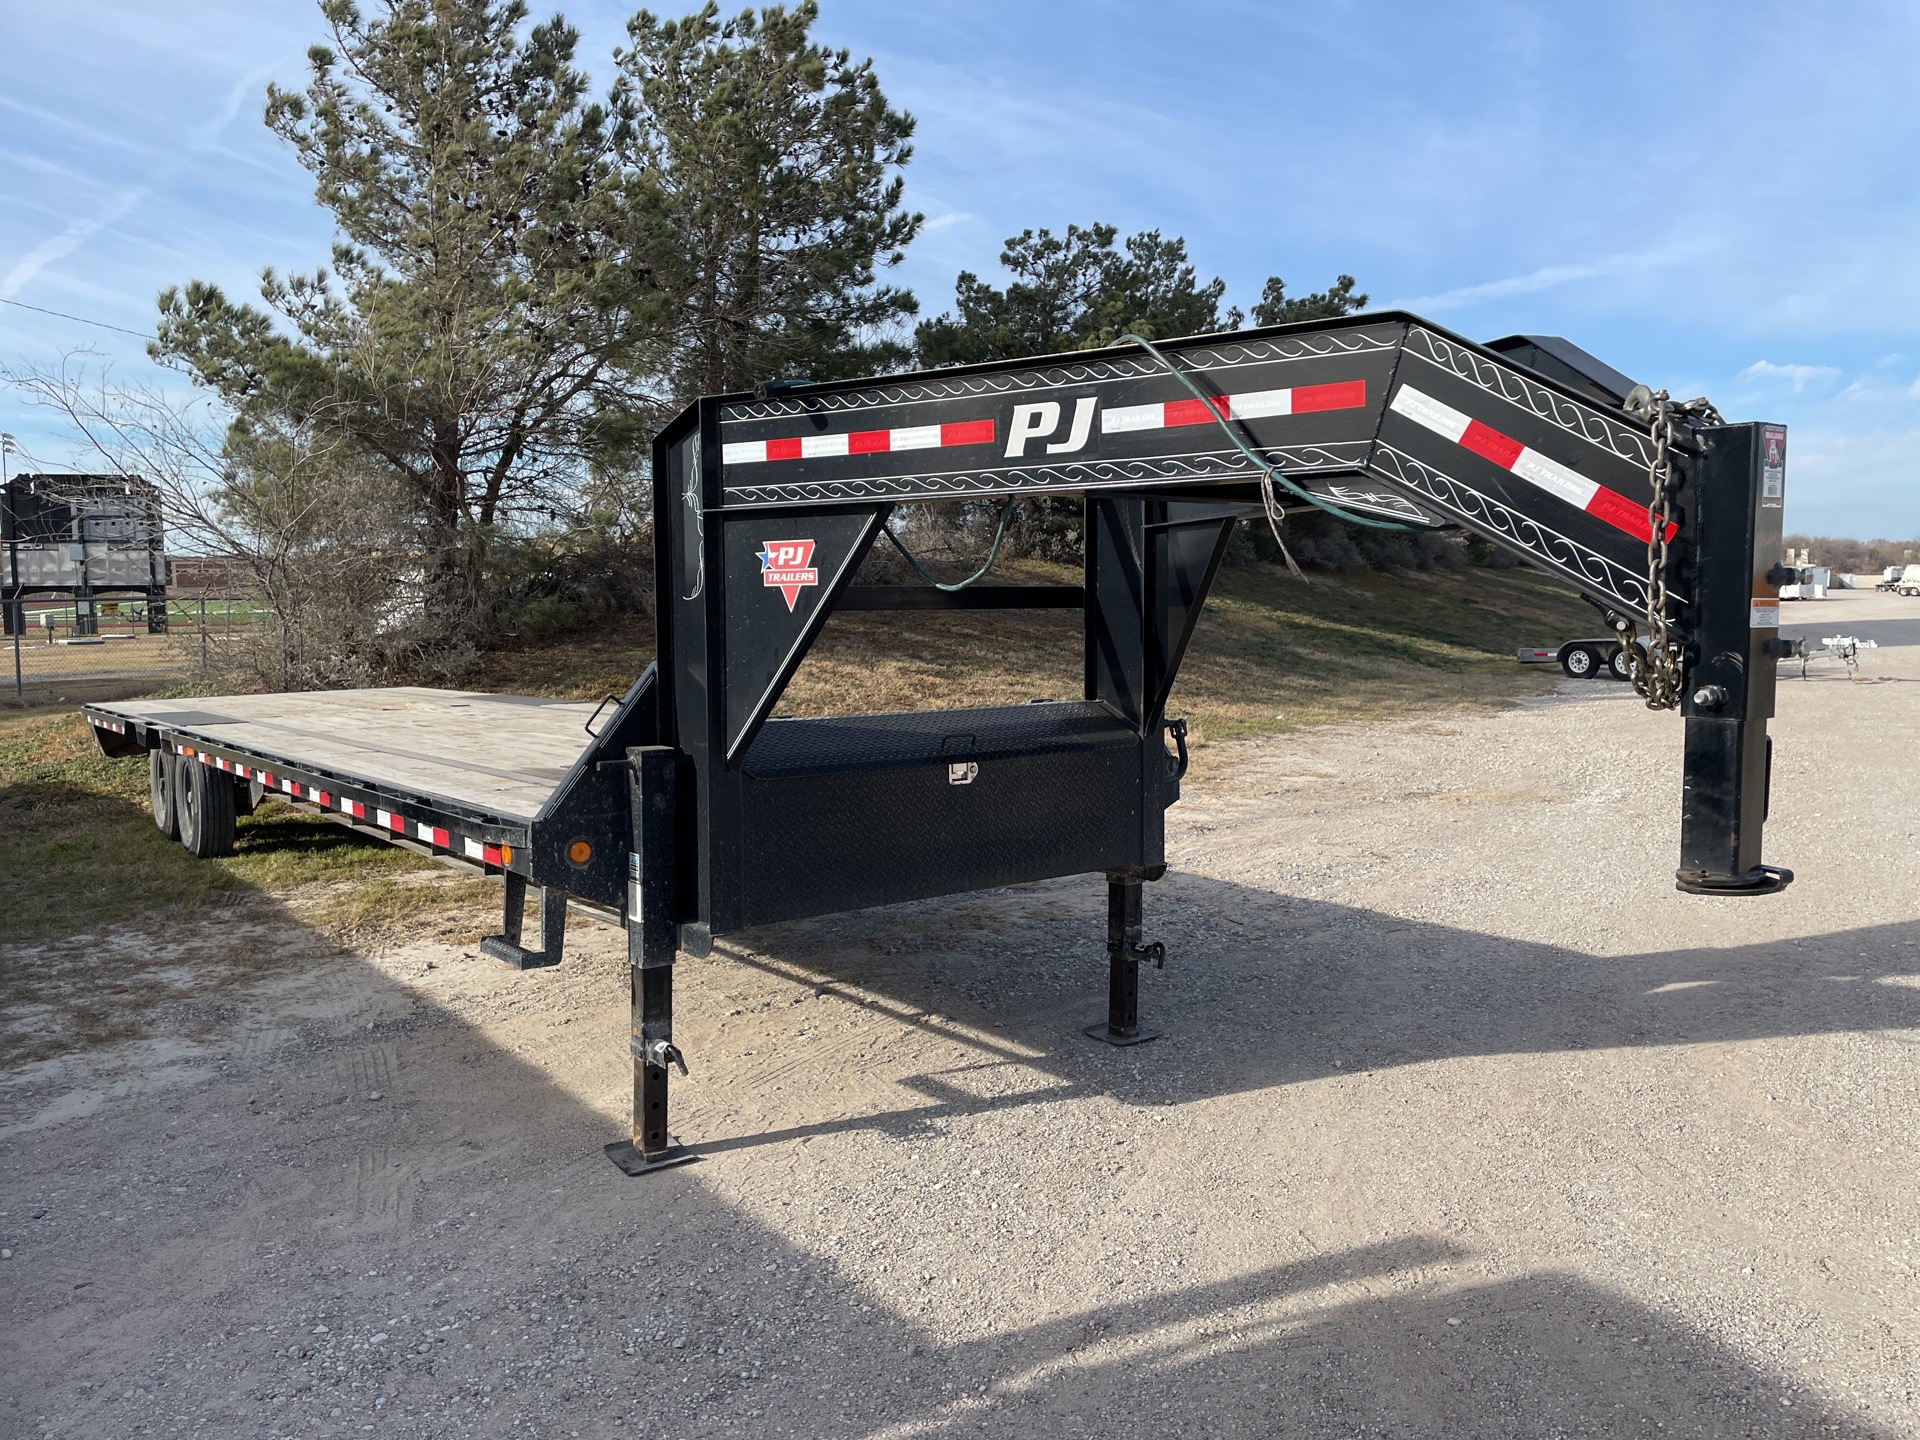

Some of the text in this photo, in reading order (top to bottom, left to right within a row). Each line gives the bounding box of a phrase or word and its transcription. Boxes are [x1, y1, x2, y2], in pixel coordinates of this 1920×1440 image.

[1003, 396, 1098, 458] PJ
[1526, 462, 1540, 473] PJ
[1539, 468, 1585, 497] TRAILERS
[778, 546, 804, 565] PJ
[768, 572, 814, 582] TRAILERS
